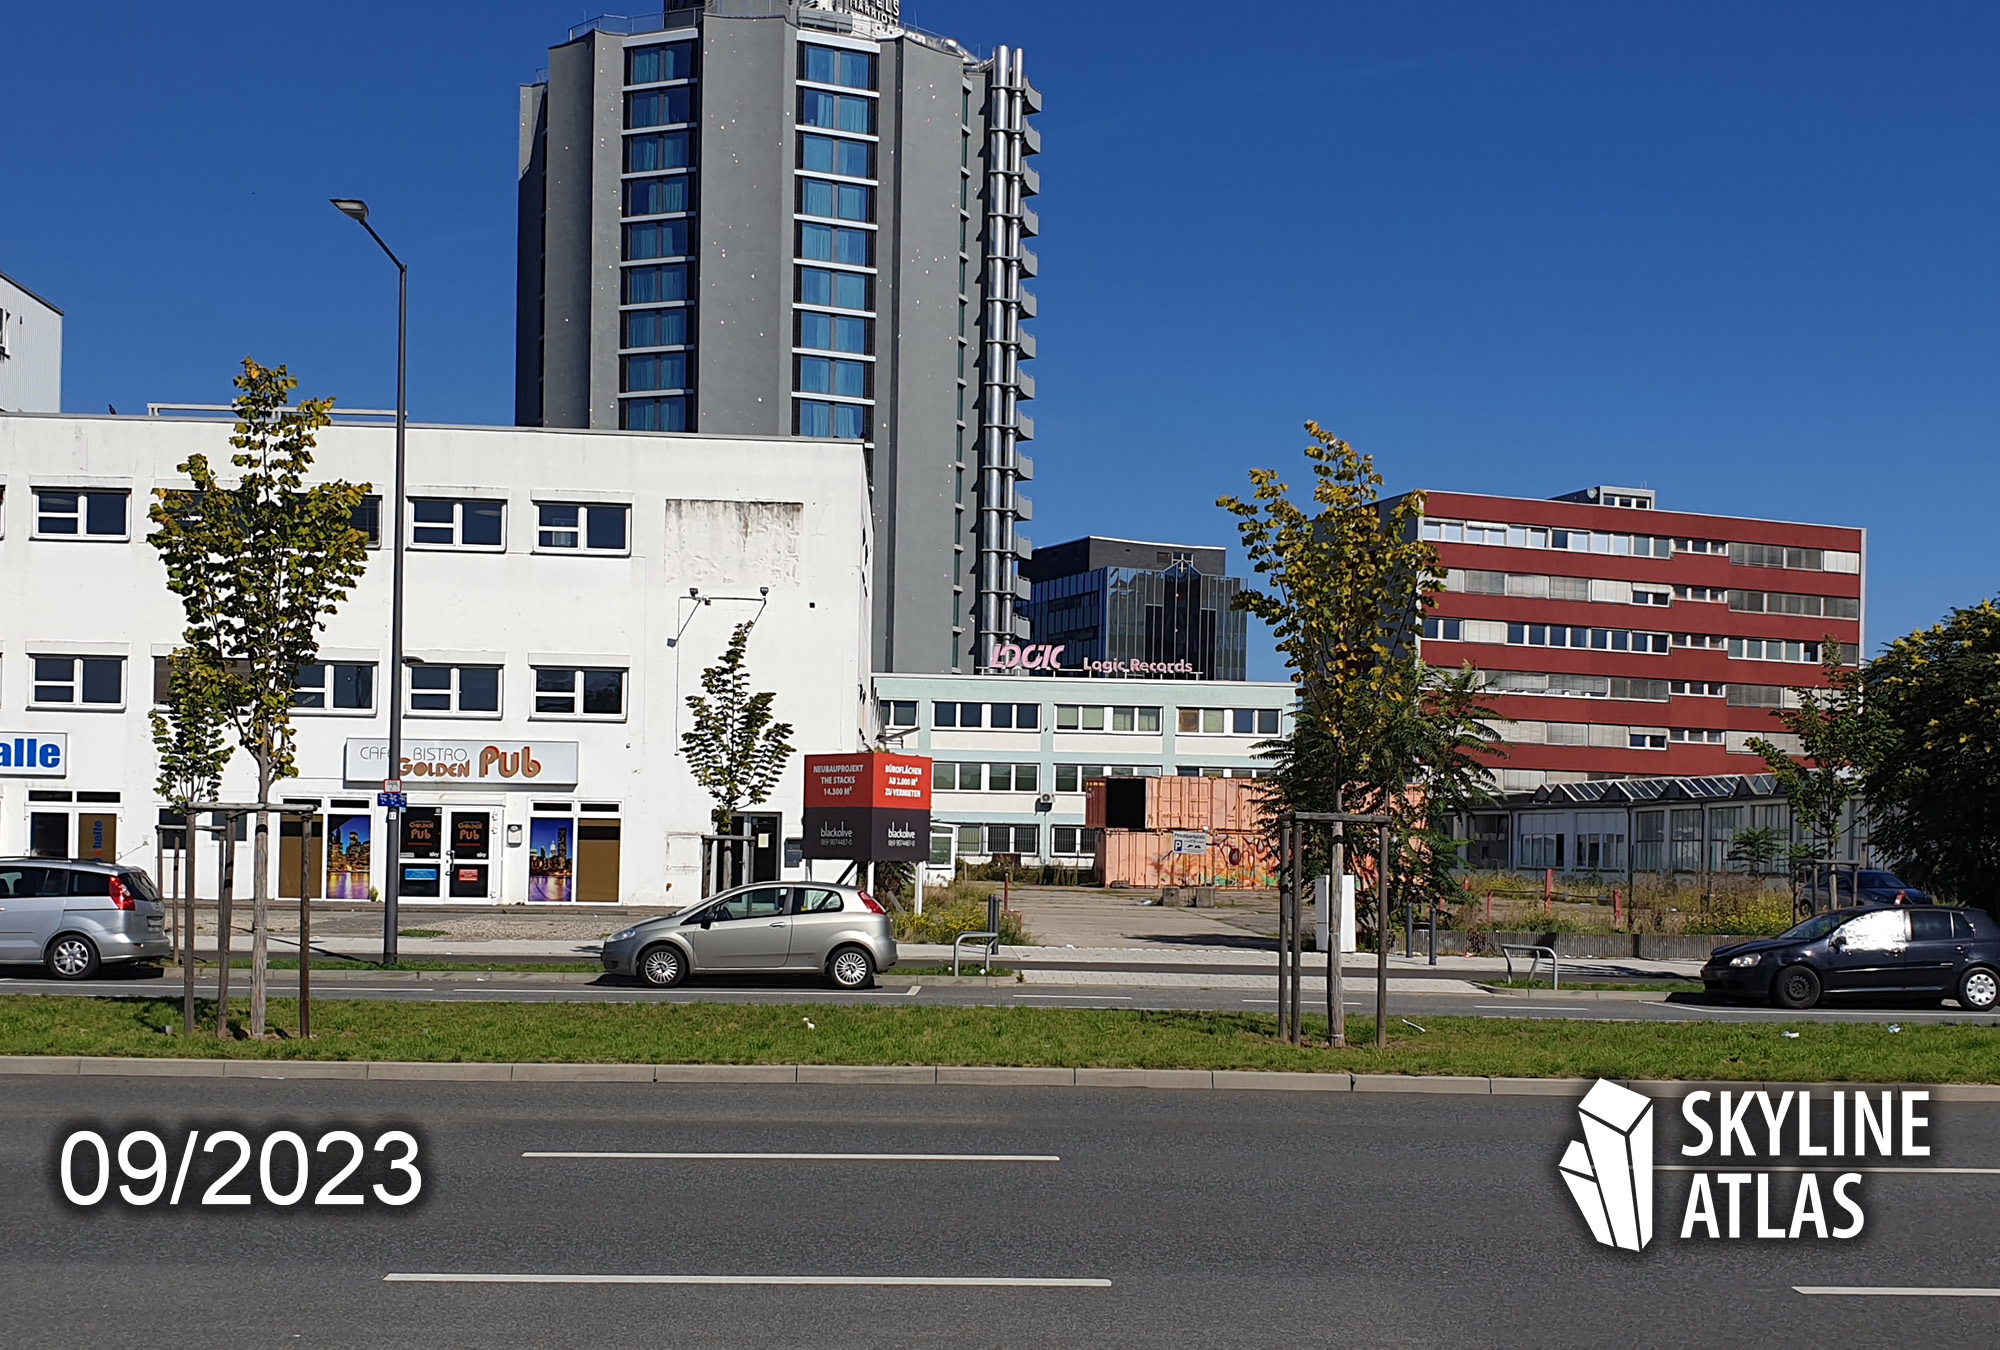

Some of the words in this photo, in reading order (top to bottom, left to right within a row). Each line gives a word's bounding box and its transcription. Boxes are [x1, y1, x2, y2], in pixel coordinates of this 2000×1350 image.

[989, 643, 1066, 669] LOGIC
[1083, 657, 1127, 674] Logic
[1129, 658, 1193, 674] Records
[0, 738, 61, 768] alle
[360, 746, 390, 760] CAF
[413, 746, 468, 762] BISTRO
[813, 764, 864, 773] NEUBAUPROJEKT
[885, 764, 922, 775] BÜROFLÄCHEN
[833, 776, 856, 784] STACKS
[888, 777, 896, 785] AB
[823, 788, 843, 796] 14.300
[893, 788, 922, 798] VERMIETEN
[820, 821, 853, 837] blackolive
[888, 821, 916, 839] blackolive
